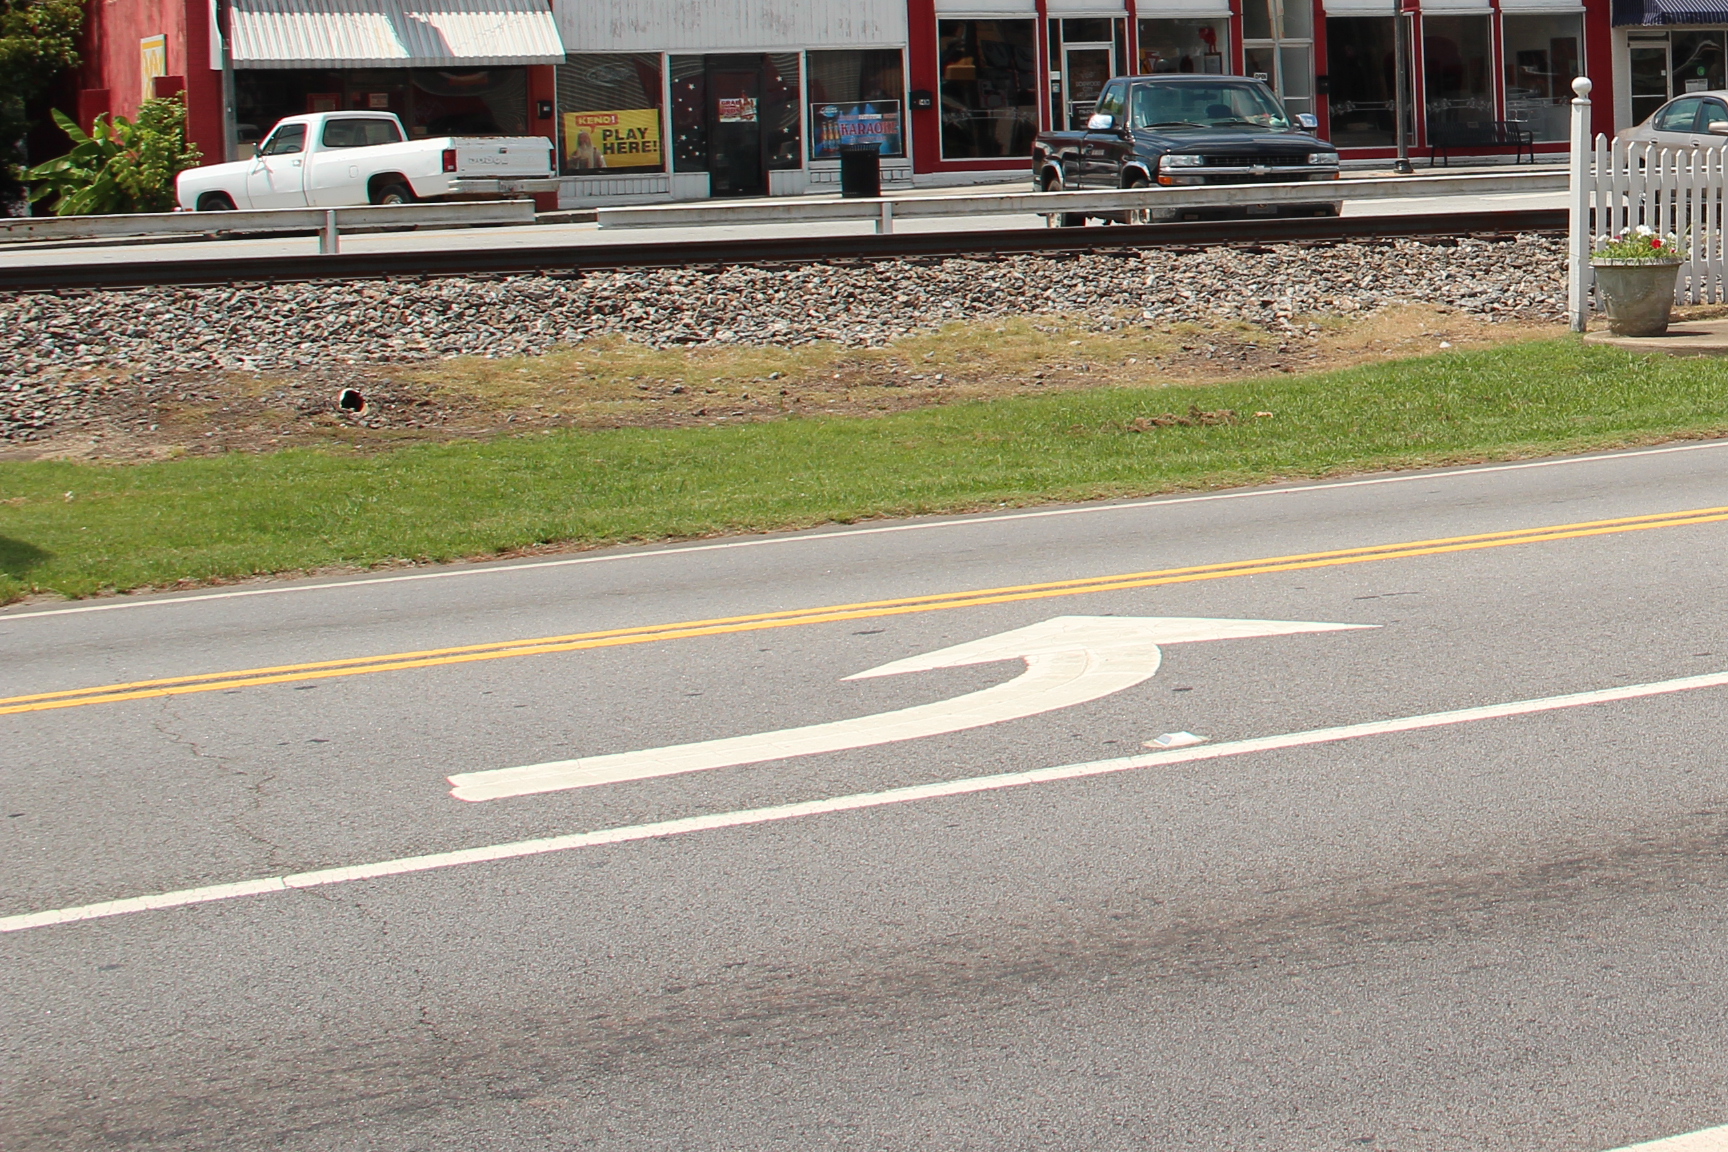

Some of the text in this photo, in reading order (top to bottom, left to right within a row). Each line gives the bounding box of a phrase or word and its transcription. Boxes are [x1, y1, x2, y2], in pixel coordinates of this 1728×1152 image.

[579, 115, 616, 124] KENO!
[602, 128, 649, 141] PLAY
[840, 120, 899, 136] KARAOKE
[603, 140, 658, 155] HERE!
